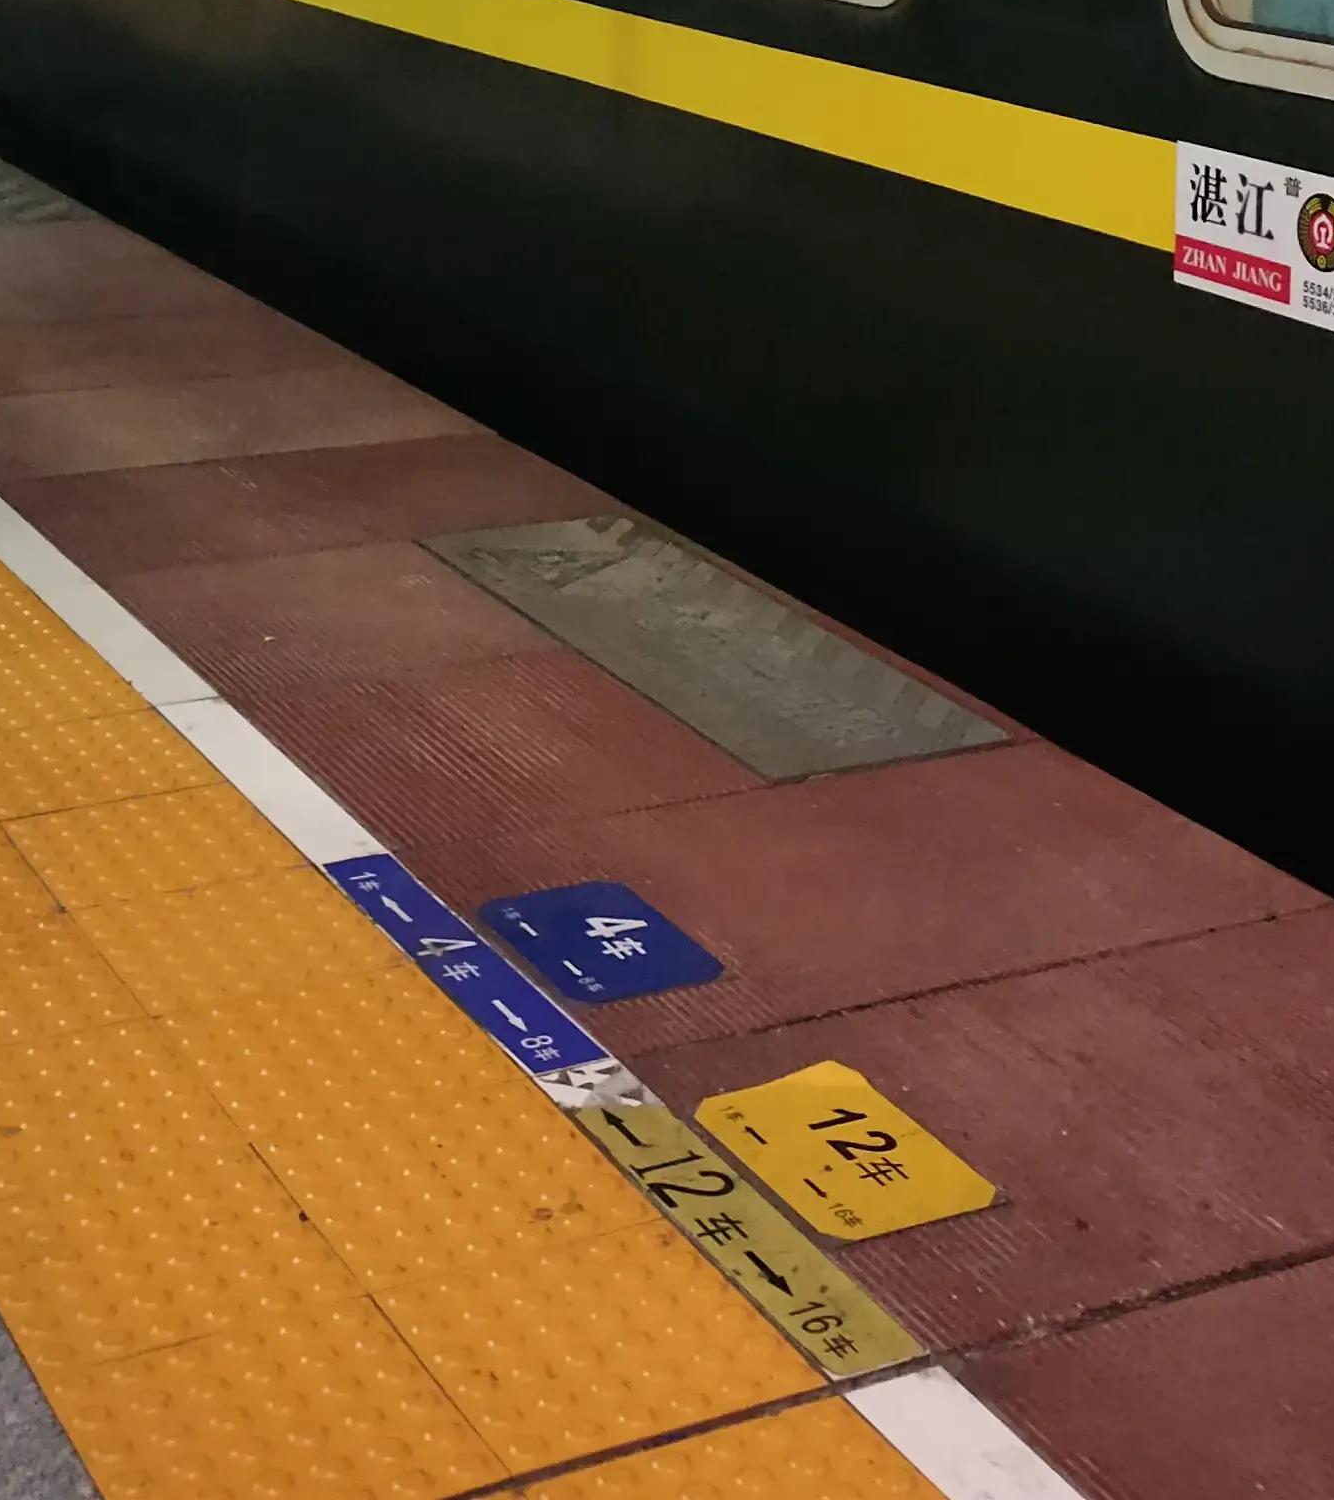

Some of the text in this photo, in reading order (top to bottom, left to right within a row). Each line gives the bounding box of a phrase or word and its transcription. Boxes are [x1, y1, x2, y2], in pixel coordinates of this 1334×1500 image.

[1190, 164, 1274, 240] 湛江
[1284, 176, 1302, 198] 普
[1183, 246, 1282, 292] ZHAN JIANG
[416, 937, 482, 982] 4车
[584, 916, 649, 960] 4车
[520, 1035, 562, 1061] 8车
[807, 1108, 910, 1187] 12车
[629, 1149, 749, 1247] 12车
[789, 1301, 859, 1359] 16车
